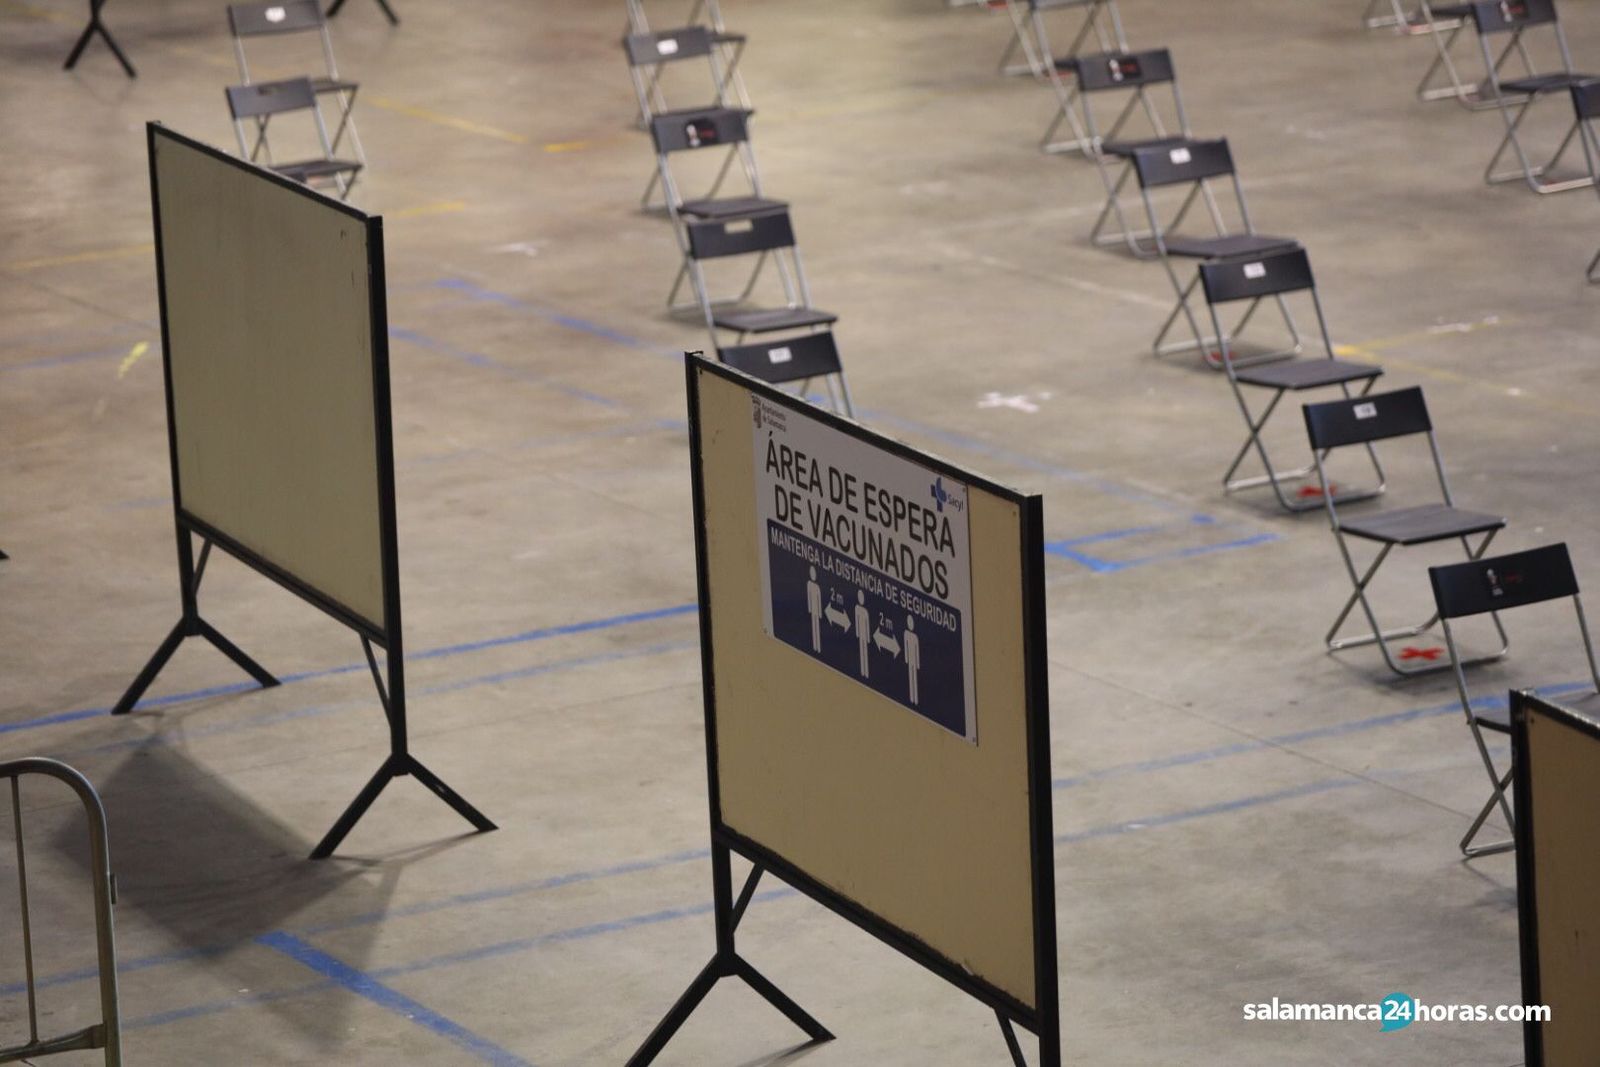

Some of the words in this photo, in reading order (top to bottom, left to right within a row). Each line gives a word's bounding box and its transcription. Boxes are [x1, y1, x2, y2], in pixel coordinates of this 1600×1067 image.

[766, 430, 823, 498] ÁREA
[828, 466, 858, 514] DE
[864, 482, 956, 558] ESPERA
[775, 484, 803, 530] DE
[807, 499, 949, 600] VACUNADOS
[771, 526, 820, 566] MANTENGA
[822, 551, 835, 573] LA
[835, 558, 884, 597] DISTANCIA
[885, 583, 899, 604] DE
[900, 590, 957, 632] SEGURIDAD
[830, 587, 836, 602] 2
[836, 593, 844, 605] m
[879, 612, 885, 626] 2
[885, 618, 893, 631] m
